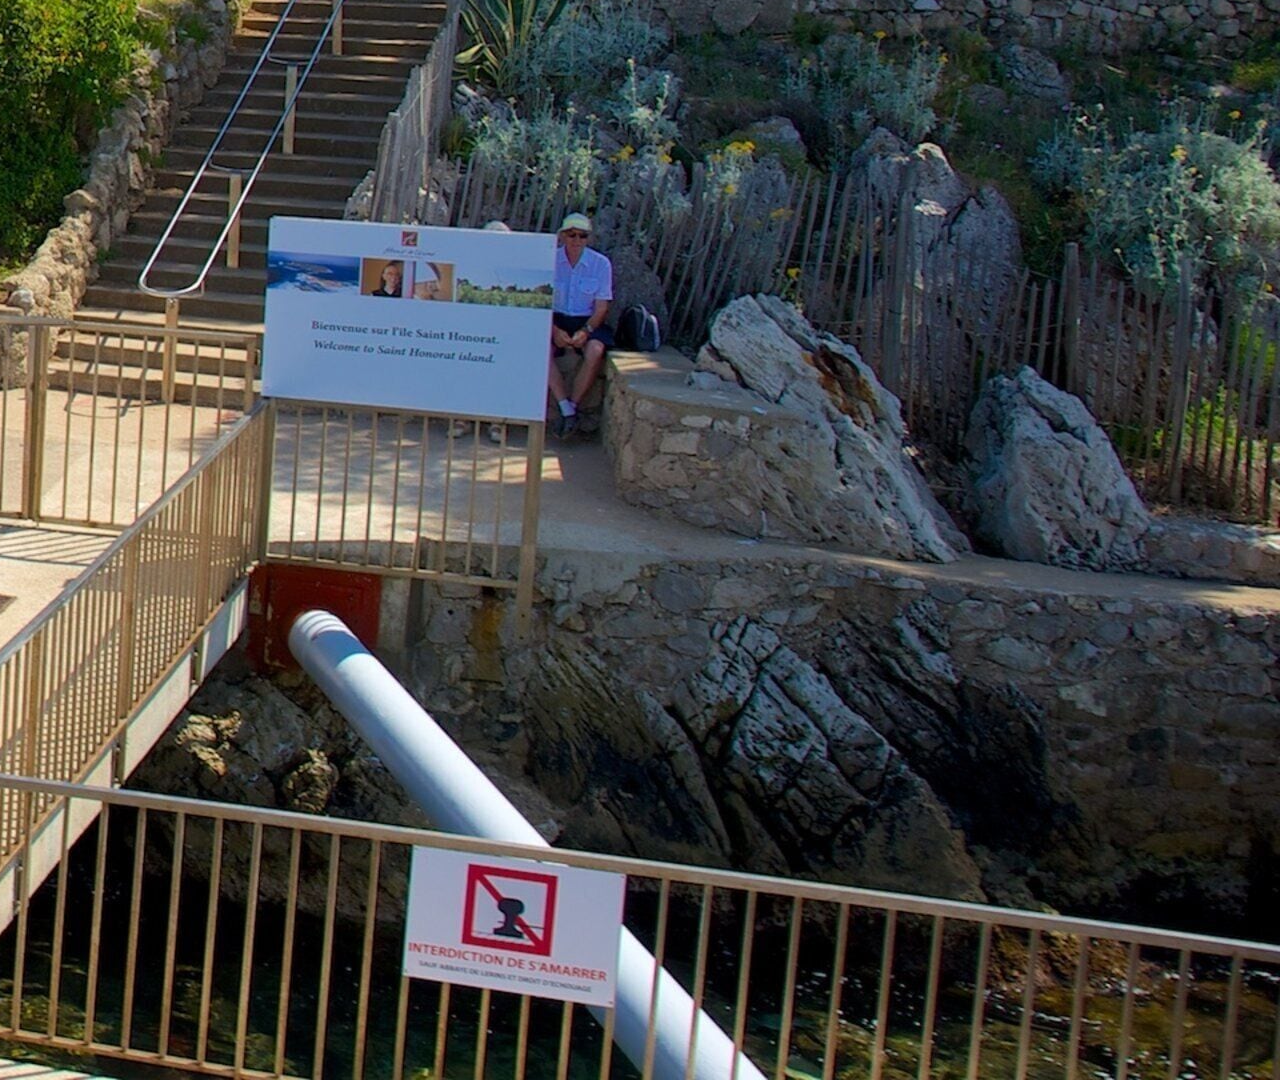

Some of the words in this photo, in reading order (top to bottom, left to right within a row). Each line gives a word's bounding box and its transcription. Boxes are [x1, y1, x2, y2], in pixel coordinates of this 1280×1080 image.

[312, 320, 368, 334] Bienvenue
[372, 327, 390, 335] sur
[416, 328, 445, 340] Saint
[448, 332, 500, 344] Honorat.
[314, 340, 360, 352] Welcome
[363, 345, 374, 353] to
[377, 345, 406, 356] Saint
[409, 348, 455, 360] Honorat
[458, 352, 496, 364] island.
[409, 942, 504, 965] INTERDICTION
[507, 957, 525, 969] DE
[529, 960, 607, 982] S'AMARRER
